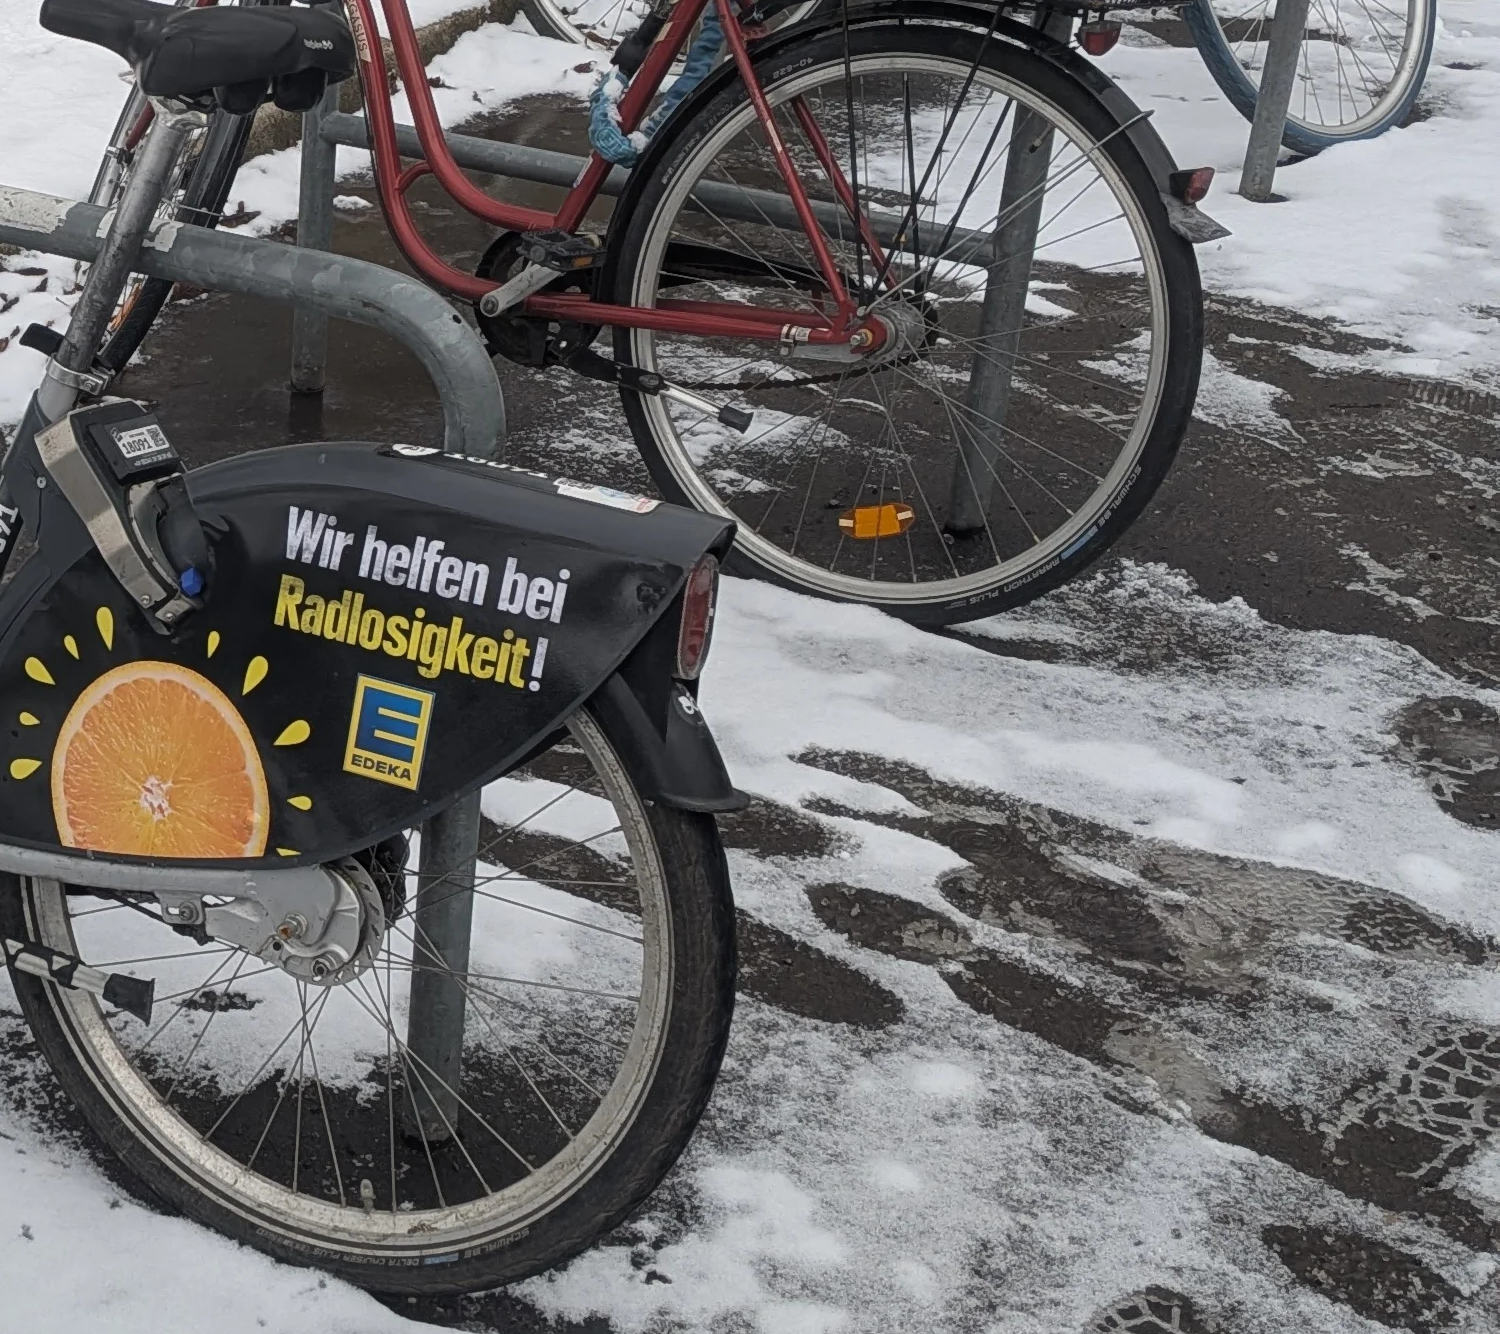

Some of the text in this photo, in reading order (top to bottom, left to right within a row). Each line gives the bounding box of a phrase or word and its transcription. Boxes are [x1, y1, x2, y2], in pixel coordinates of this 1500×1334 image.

[122, 437, 154, 455] 18091
[285, 505, 571, 624] Wir helfen bei
[273, 573, 549, 692] Radlosigkeit!
[350, 752, 412, 782] EDEKA
